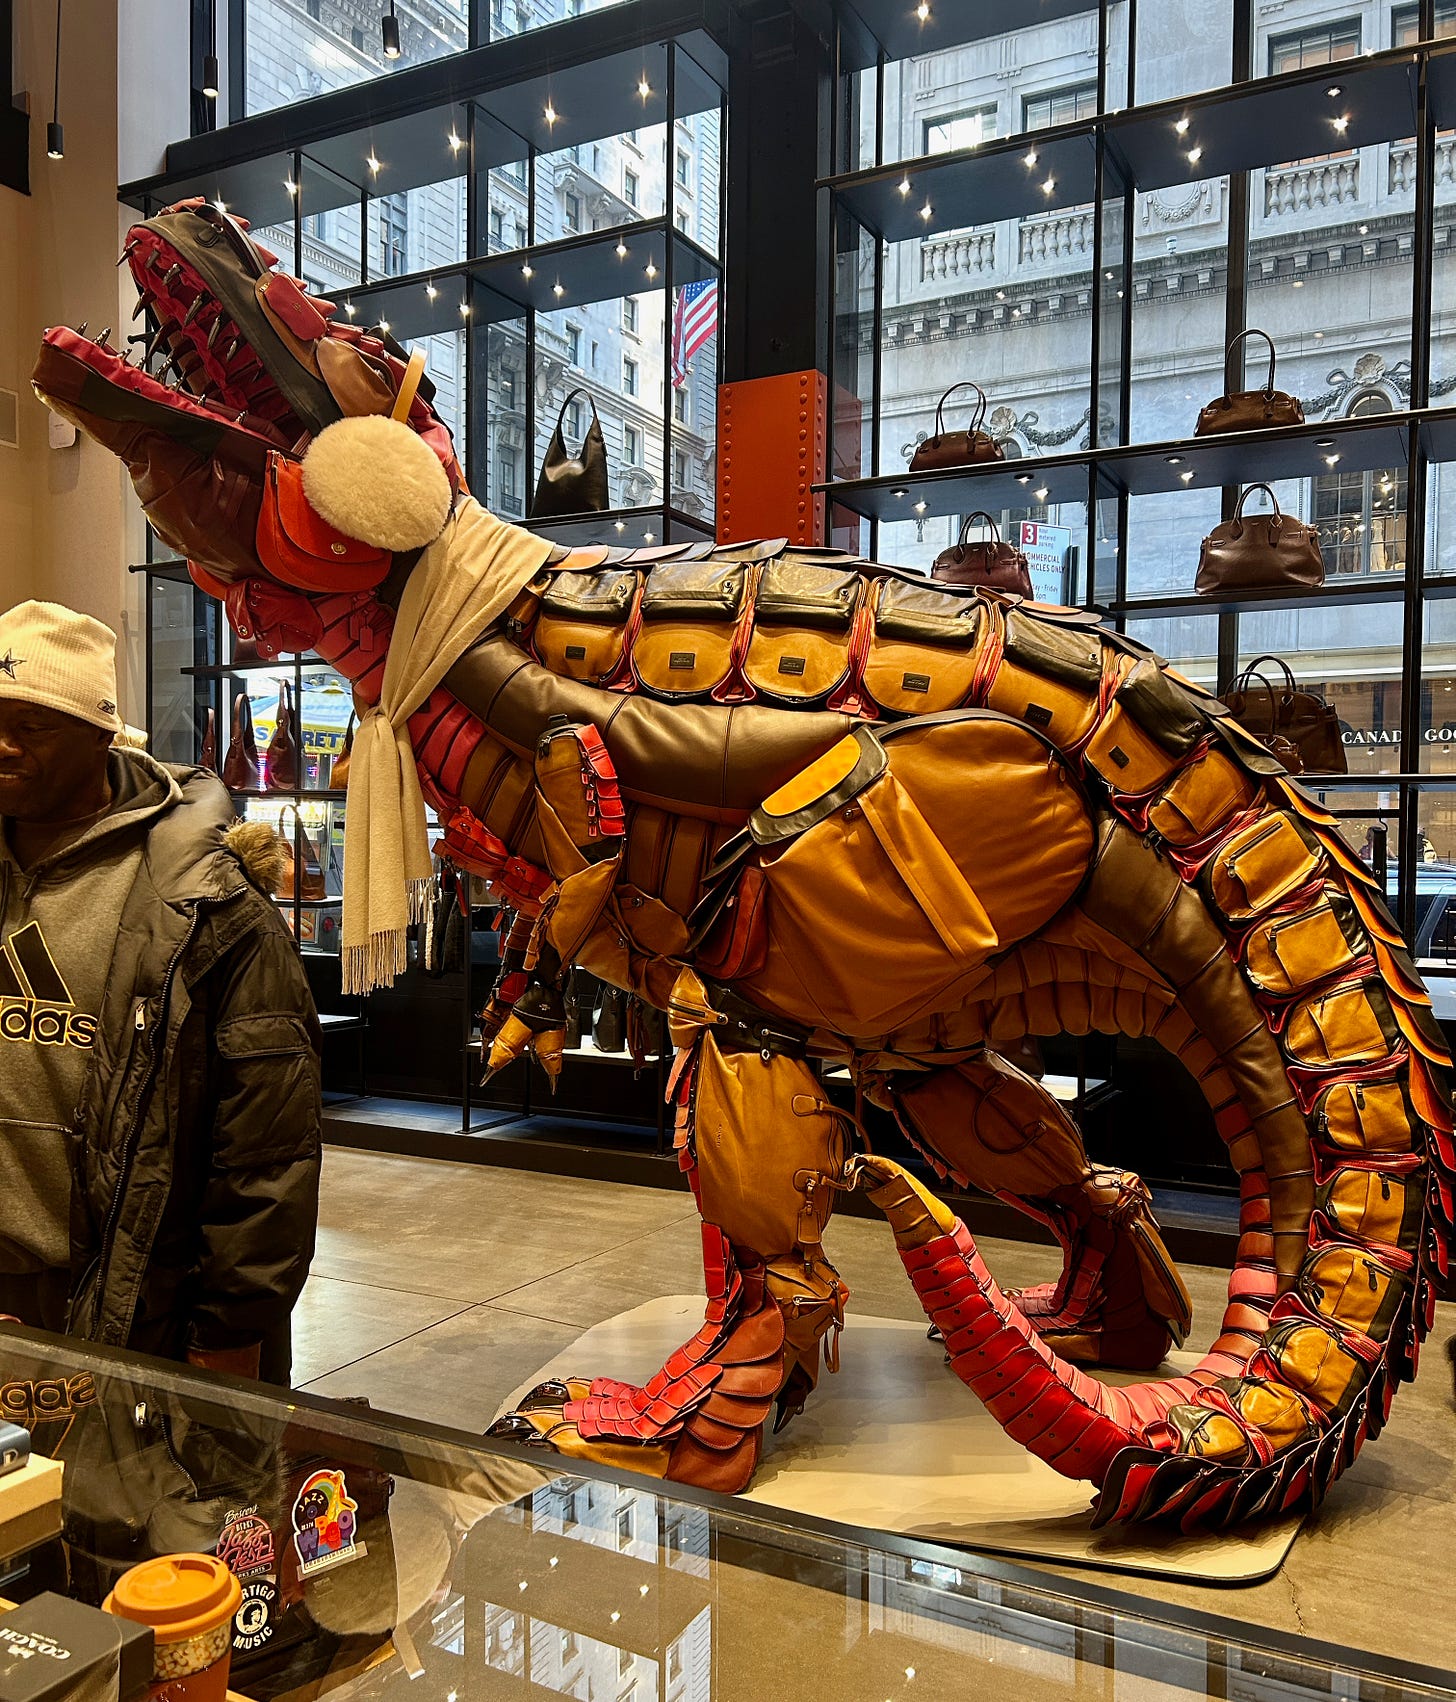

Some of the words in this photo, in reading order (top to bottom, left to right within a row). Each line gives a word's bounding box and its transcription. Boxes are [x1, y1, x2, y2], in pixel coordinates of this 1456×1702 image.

[1025, 525, 1034, 543] 3
[1026, 552, 1060, 563] OMMERCIAL
[252, 726, 347, 748] SRET
[1341, 730, 1402, 744] CANAD
[299, 1493, 325, 1512] JAZZ
[217, 1524, 271, 1558] Jazz
[241, 1584, 275, 1600] RTIGO
[233, 1626, 273, 1650] MUSIC
